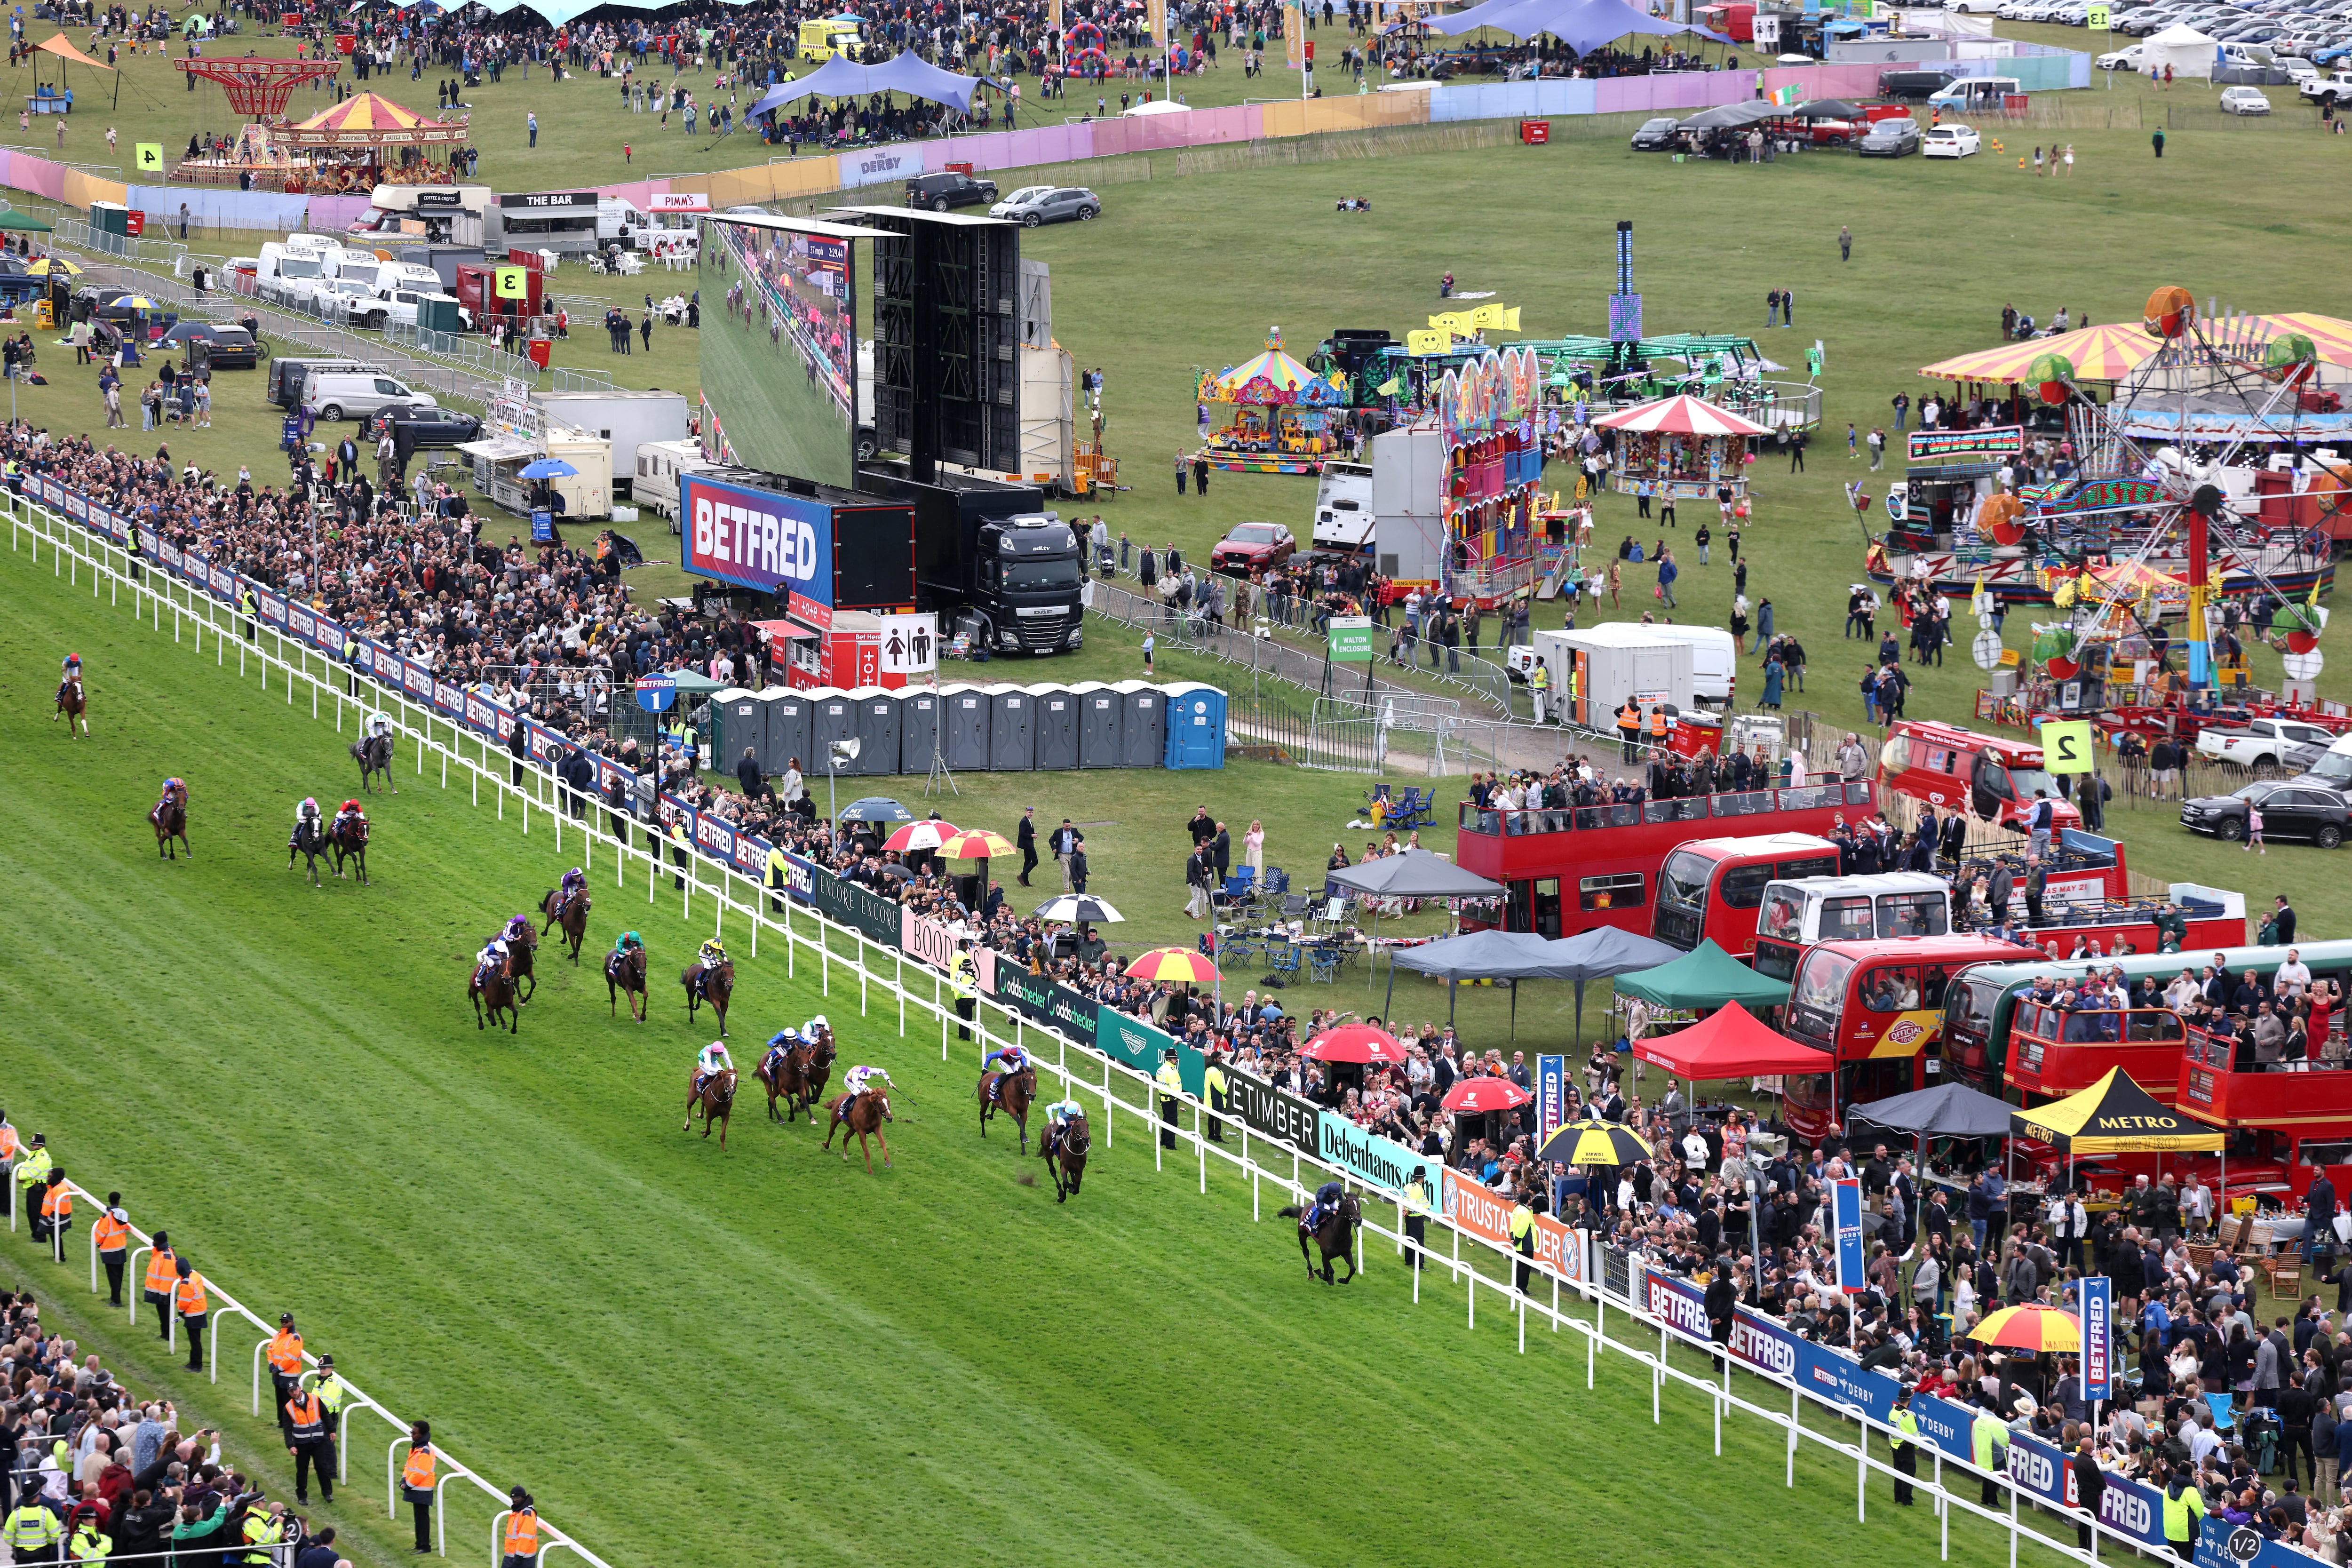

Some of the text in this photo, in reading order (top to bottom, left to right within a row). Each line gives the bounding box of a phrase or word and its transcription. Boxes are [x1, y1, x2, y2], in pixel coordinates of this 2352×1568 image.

[861, 157, 901, 174] DERBY
[527, 195, 572, 205] THE BAR
[666, 195, 693, 206] PIMM'S
[810, 246, 815, 254] 37
[829, 247, 843, 258] 2:29.44
[835, 276, 843, 284] 12.19
[510, 382, 522, 397] CHIPS
[497, 405, 517, 425] BURGERS
[523, 413, 536, 433] DOGS
[1301, 420, 1326, 430] FUN BUS
[44, 482, 64, 507] BETFRED
[497, 486, 511, 502] BURGER
[65, 494, 86, 518] BETFRED
[88, 505, 110, 530] BETFRED
[696, 497, 816, 581] BETFRED
[159, 539, 182, 567] BETFRED
[1542, 549, 1560, 558] PAY
[184, 554, 207, 581] BETFRED
[209, 568, 232, 595] BETFRED
[261, 594, 285, 622] BETFRED
[801, 601, 818, 619] tote
[289, 608, 314, 637] BETFRED
[317, 621, 342, 651] BETFRED
[375, 650, 402, 681] BETFRED
[405, 666, 432, 697] BETFRED
[636, 679, 674, 688] BETFRED
[435, 681, 463, 713] BETFRED
[651, 692, 660, 709] 1
[467, 697, 495, 730] BETFRED
[1923, 732, 1936, 742] Fancy
[1951, 739, 1968, 748] Cream?
[551, 749, 556, 758] 1
[698, 817, 731, 854] BETFRED
[820, 875, 854, 912] ENCORE
[862, 895, 897, 932] ENCORE
[1007, 976, 1045, 1009] oddschecker
[1056, 1003, 1095, 1034] oddschecker
[1891, 1027, 1923, 1039] OFFICIAL
[1647, 1052, 1658, 1062] MOYNE
[1658, 1056, 1669, 1067] LONDON
[2024, 1061, 2036, 1072] PRIVATE
[2201, 1092, 2212, 1103] RACES
[1224, 1075, 1314, 1147] YETIMBER
[2098, 1116, 2177, 1129] METRO
[2025, 1123, 2054, 1144] METRO
[2114, 1136, 2180, 1150] METRO
[1728, 1317, 1795, 1374] BETFRED
[2046, 1340, 2080, 1352] MARTYN
[2090, 1296, 2105, 1381] BETFRED
[1814, 1366, 1837, 1387] BETFRED
[1849, 1383, 1873, 1404] DERBY
[1928, 1418, 1954, 1440] DERBY
[2206, 1526, 2215, 1535] THE
[2233, 1538, 2256, 1552] 1/2
